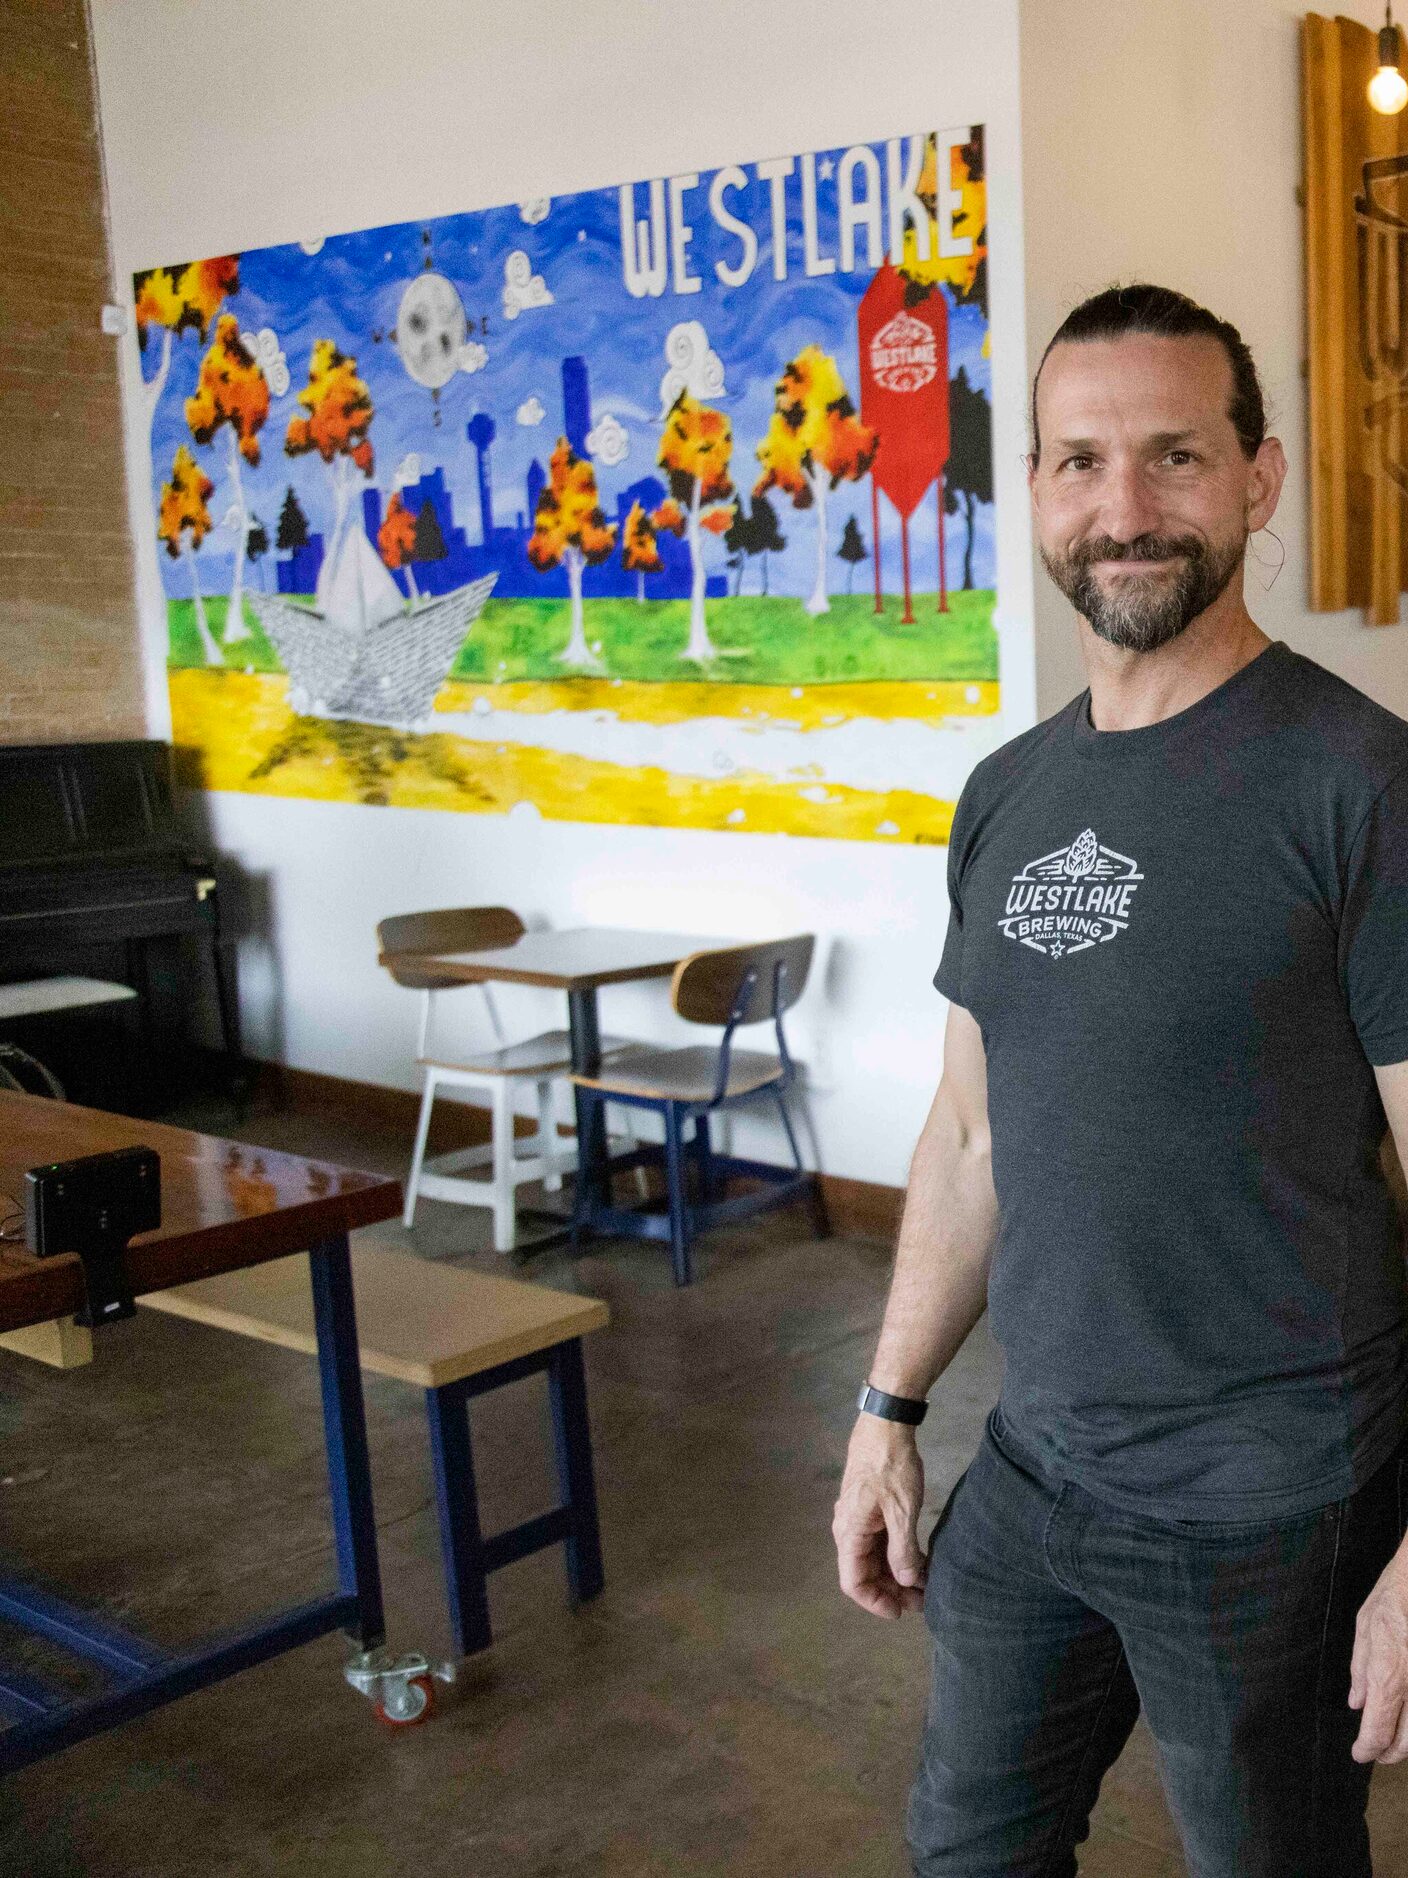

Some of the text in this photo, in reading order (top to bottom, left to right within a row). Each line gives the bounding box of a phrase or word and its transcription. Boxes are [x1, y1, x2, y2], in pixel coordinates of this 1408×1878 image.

[619, 128, 975, 299] WESTLAKE
[1005, 884, 1138, 918] WESTLAKE
[1018, 915, 1102, 938] BREWING
[1064, 931, 1083, 942] TEXAS
